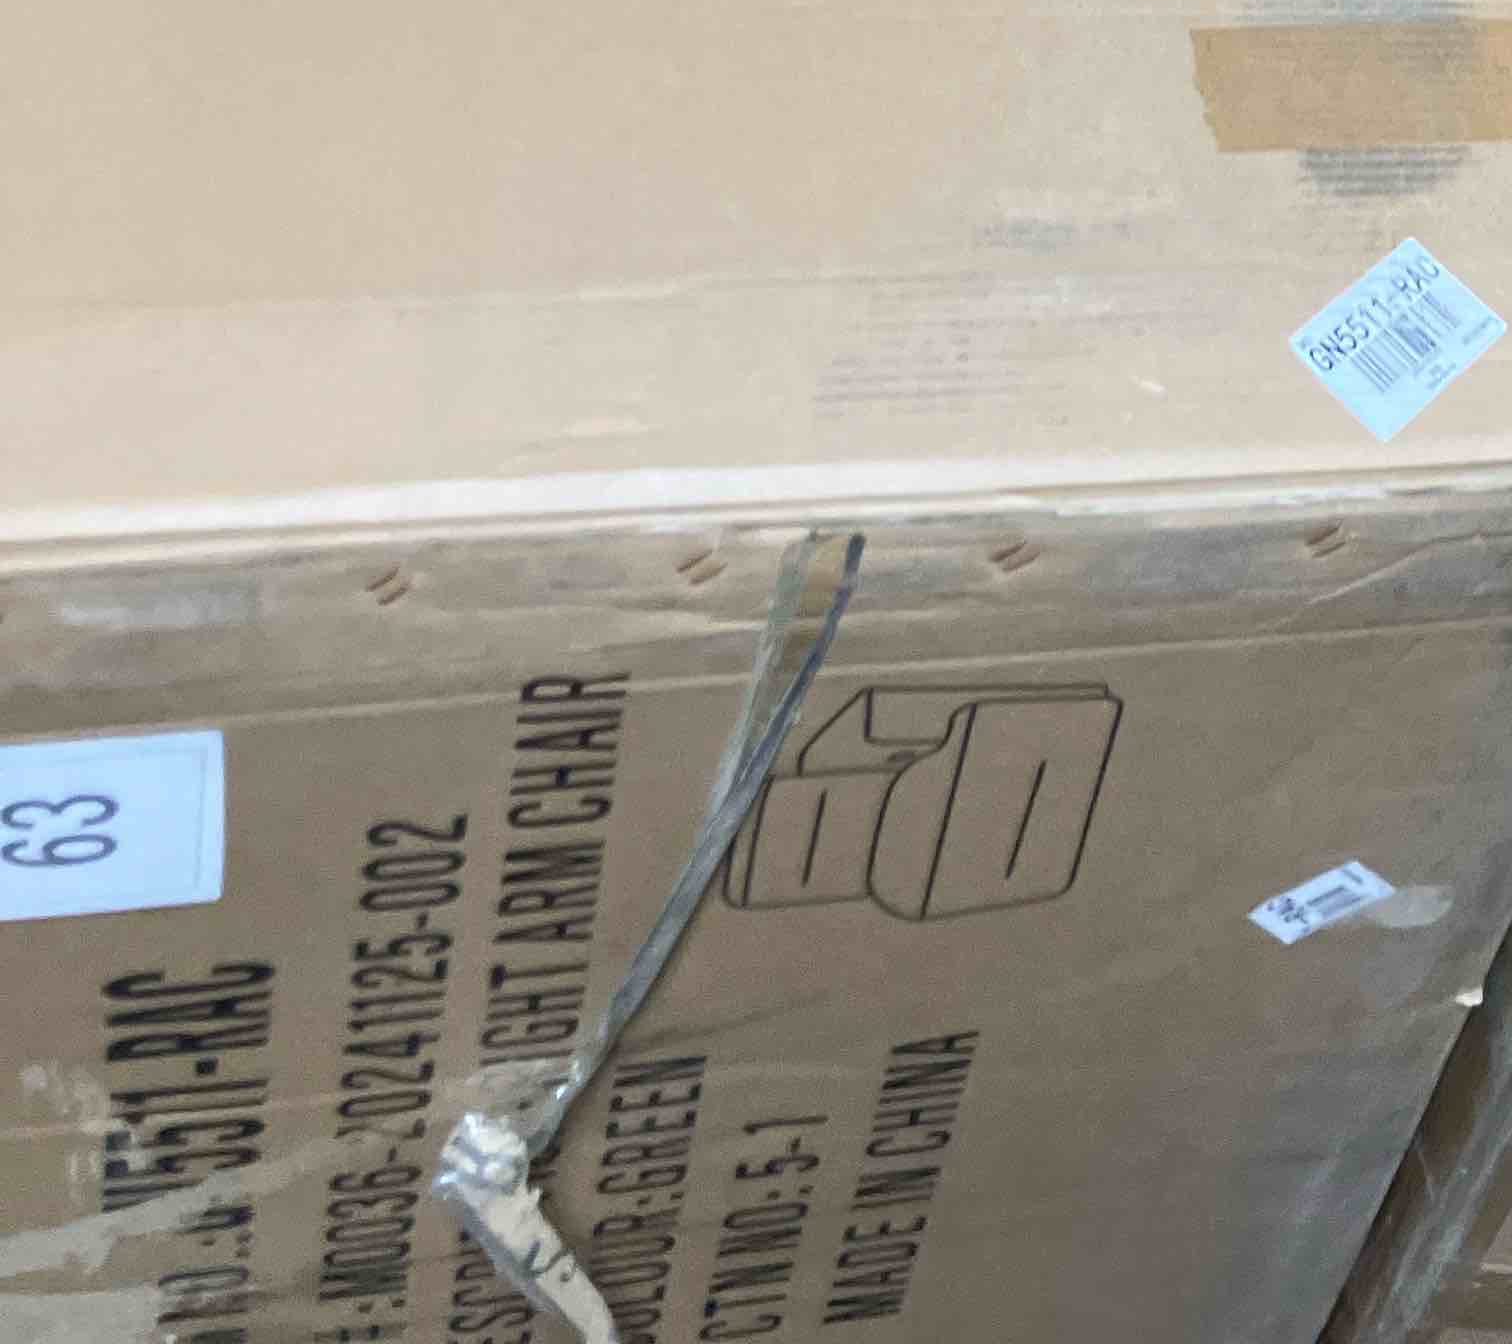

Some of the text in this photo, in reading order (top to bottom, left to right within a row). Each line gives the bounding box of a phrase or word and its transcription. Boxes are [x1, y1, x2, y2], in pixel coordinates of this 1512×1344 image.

[507, 672, 632, 830] CHAIR
[1, 792, 121, 869] 63
[495, 840, 605, 945] ARM
[822, 1030, 980, 1325] MADE IN CHINA
[698, 1262, 794, 1341] CTN
